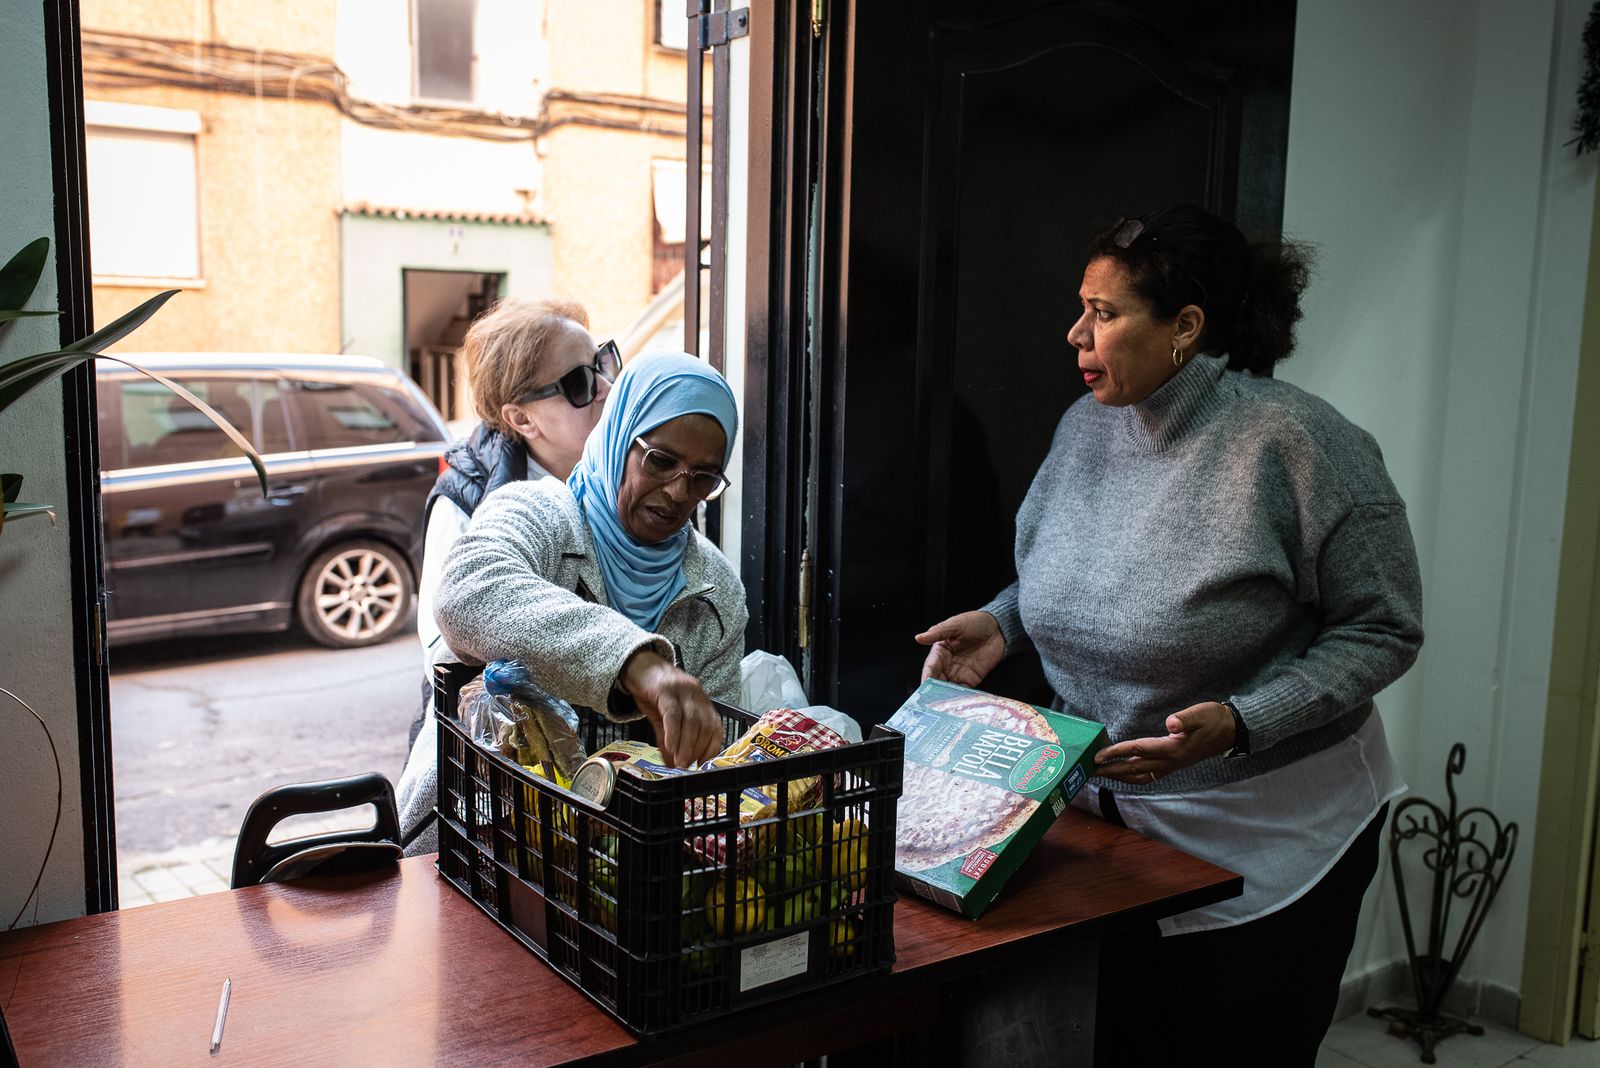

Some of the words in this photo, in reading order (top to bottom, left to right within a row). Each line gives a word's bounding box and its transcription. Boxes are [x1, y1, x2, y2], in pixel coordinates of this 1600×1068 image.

[952, 729, 1007, 775] NAPOLI
[973, 735, 1032, 779] BELLA
[1014, 743, 1061, 791] Buitoni
